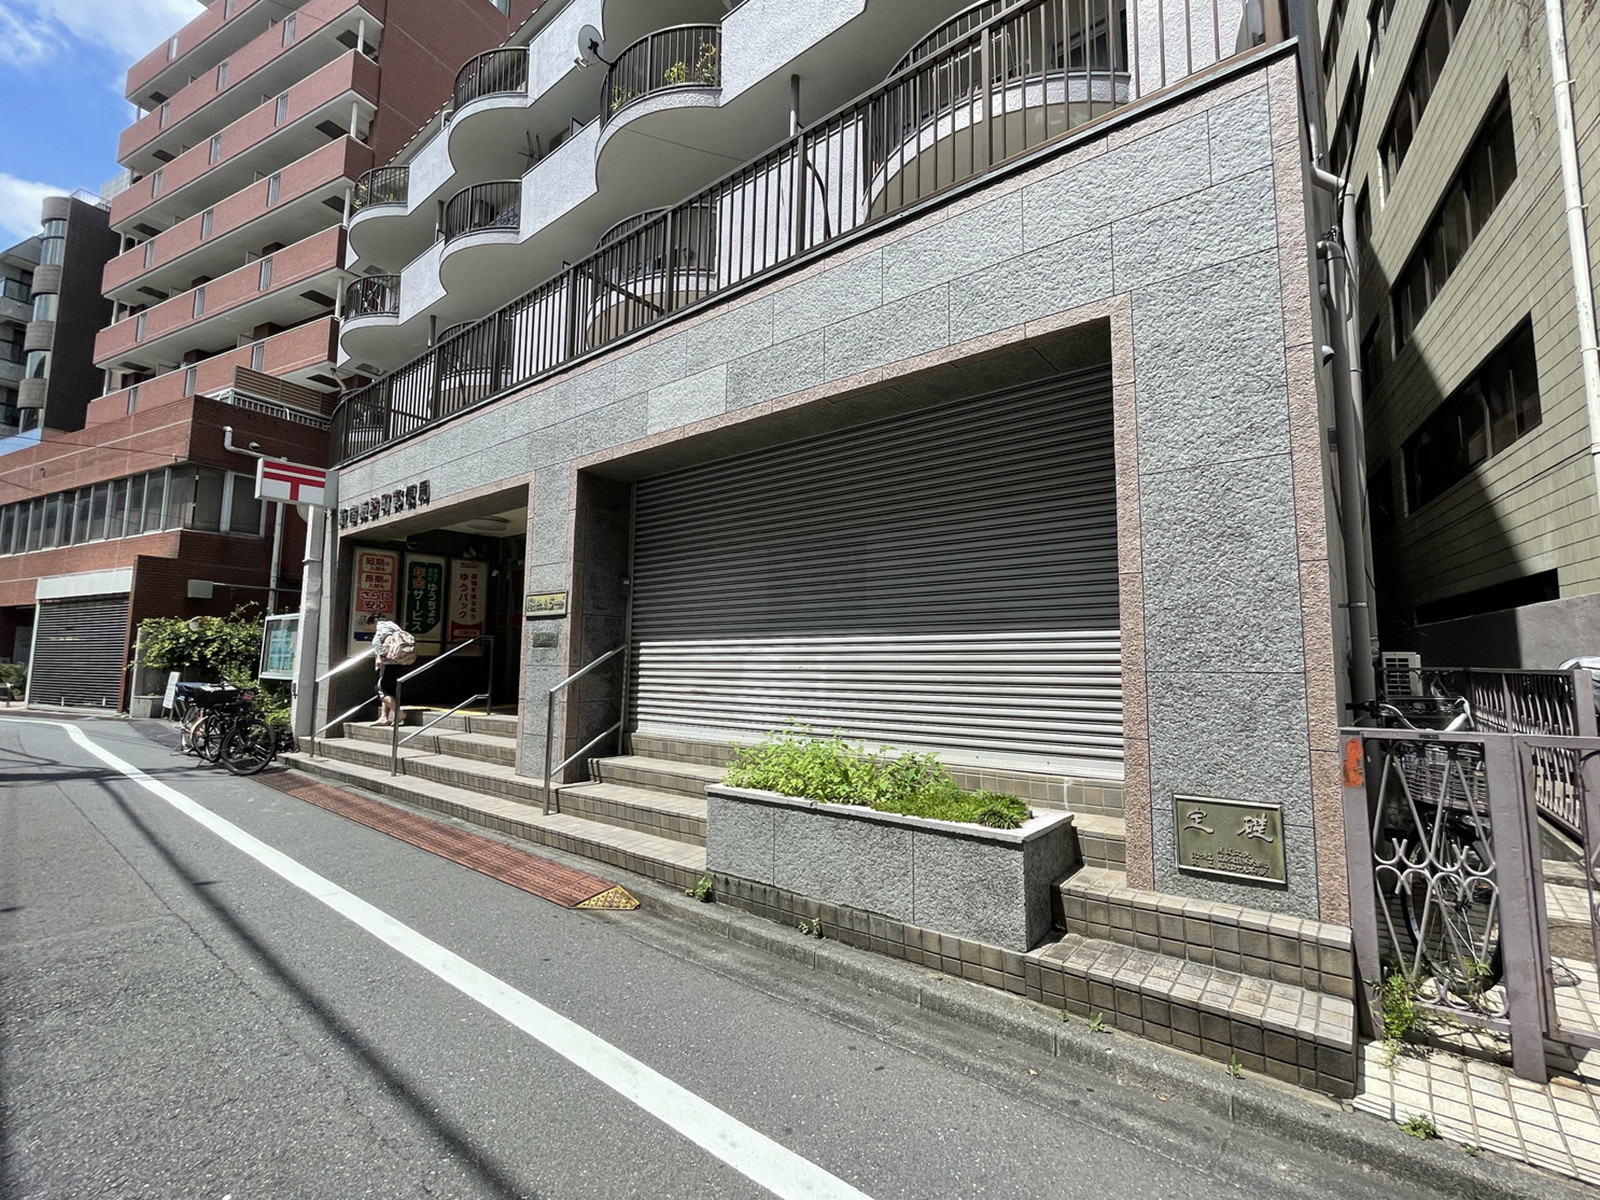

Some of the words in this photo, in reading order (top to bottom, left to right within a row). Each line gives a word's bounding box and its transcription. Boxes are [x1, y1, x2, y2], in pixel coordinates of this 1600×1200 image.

[361, 591, 392, 601] さらに
[363, 600, 387, 611] 安心
[411, 566, 426, 632] 年金サービス
[426, 582, 438, 625] ゆうちょの
[458, 573, 469, 619] ゆうパック
